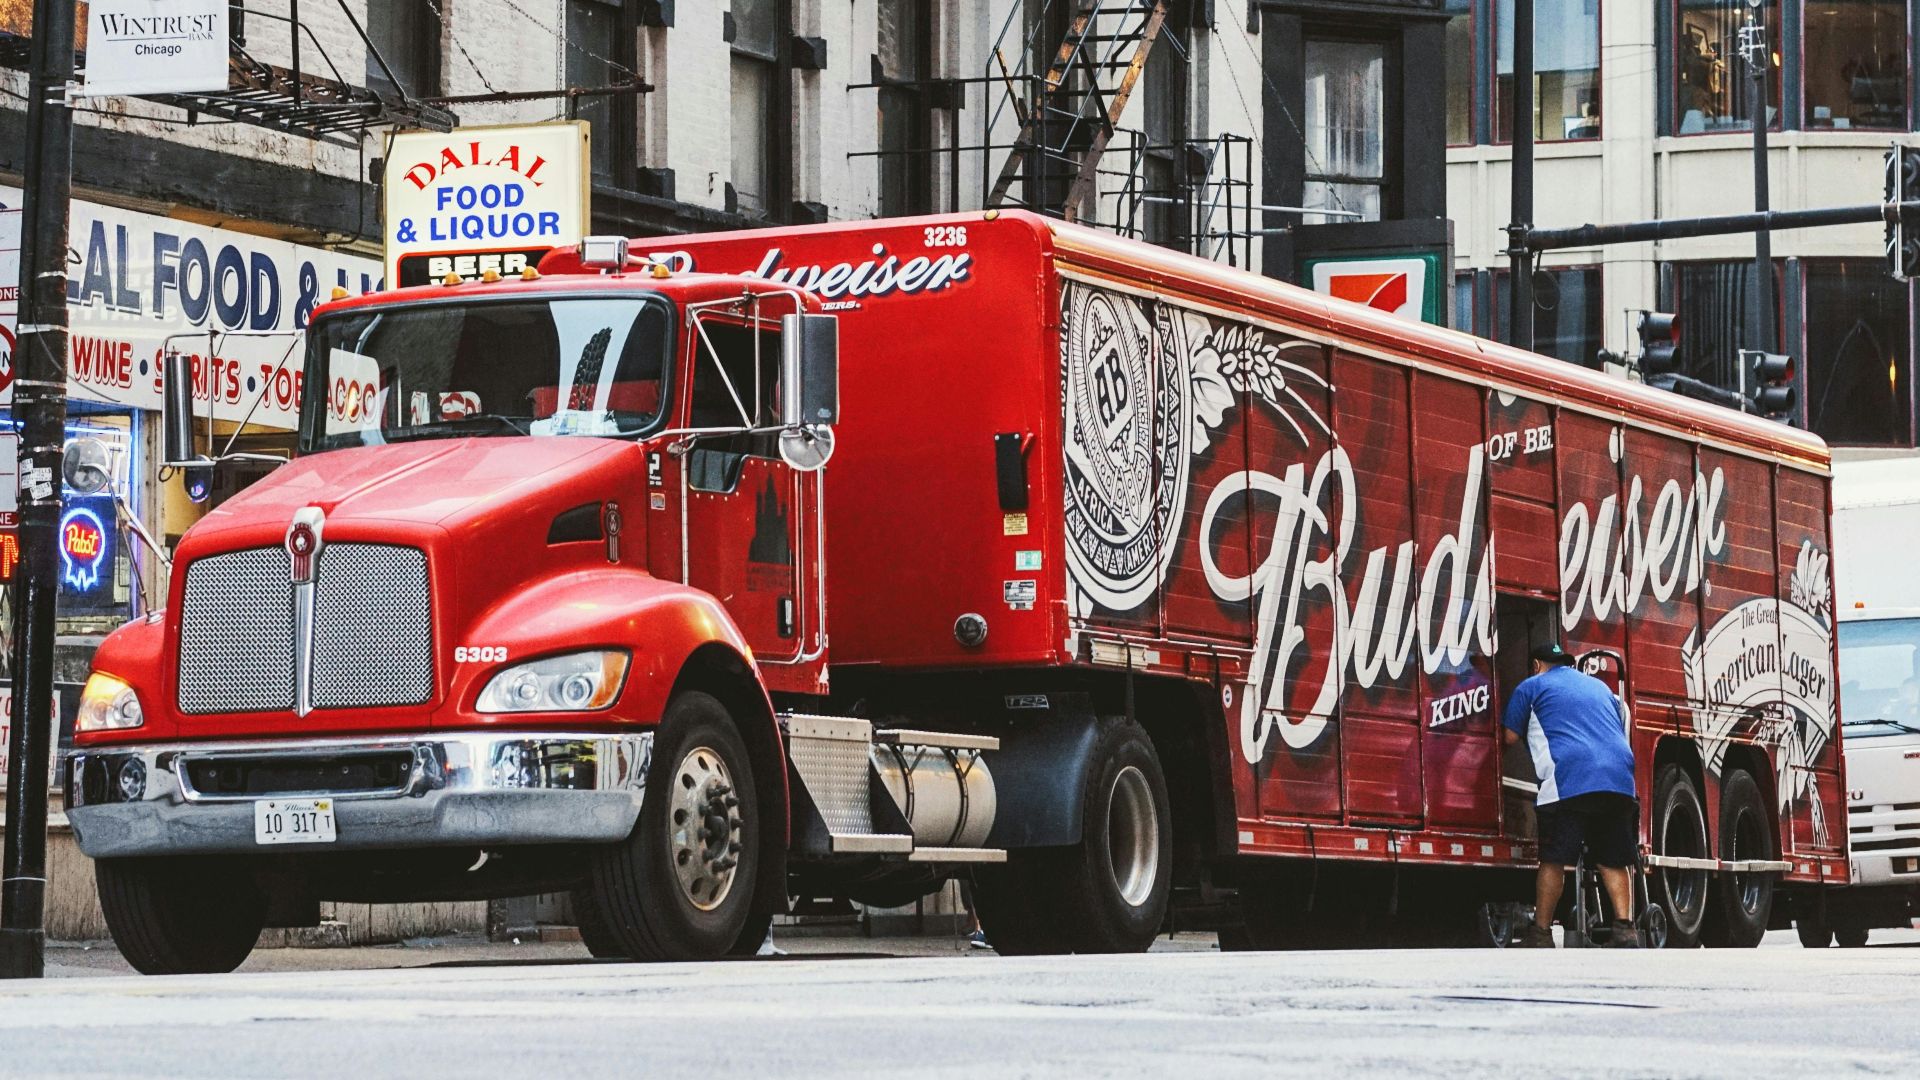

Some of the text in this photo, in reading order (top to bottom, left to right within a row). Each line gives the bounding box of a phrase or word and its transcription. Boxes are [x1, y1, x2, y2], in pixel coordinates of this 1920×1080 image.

[100, 14, 217, 36] WINTRUST
[135, 44, 182, 57] Chicago
[403, 141, 548, 191] DALAL
[437, 183, 524, 211] FOOD
[396, 212, 560, 243] & LIQUOR
[924, 226, 967, 247] 3236
[429, 254, 527, 277] BEER
[152, 231, 281, 331] FOOD
[72, 333, 133, 388] WINE
[1489, 431, 1518, 461] OF
[1077, 477, 1113, 535] AFRICA
[66, 524, 99, 556] Pabst
[1126, 510, 1168, 571] AMERICA
[1741, 606, 1755, 629] The
[455, 646, 508, 663] 6303
[1782, 633, 1826, 699] Lager
[1429, 685, 1490, 728] KING
[265, 813, 283, 834] 10
[292, 812, 317, 833] 317
